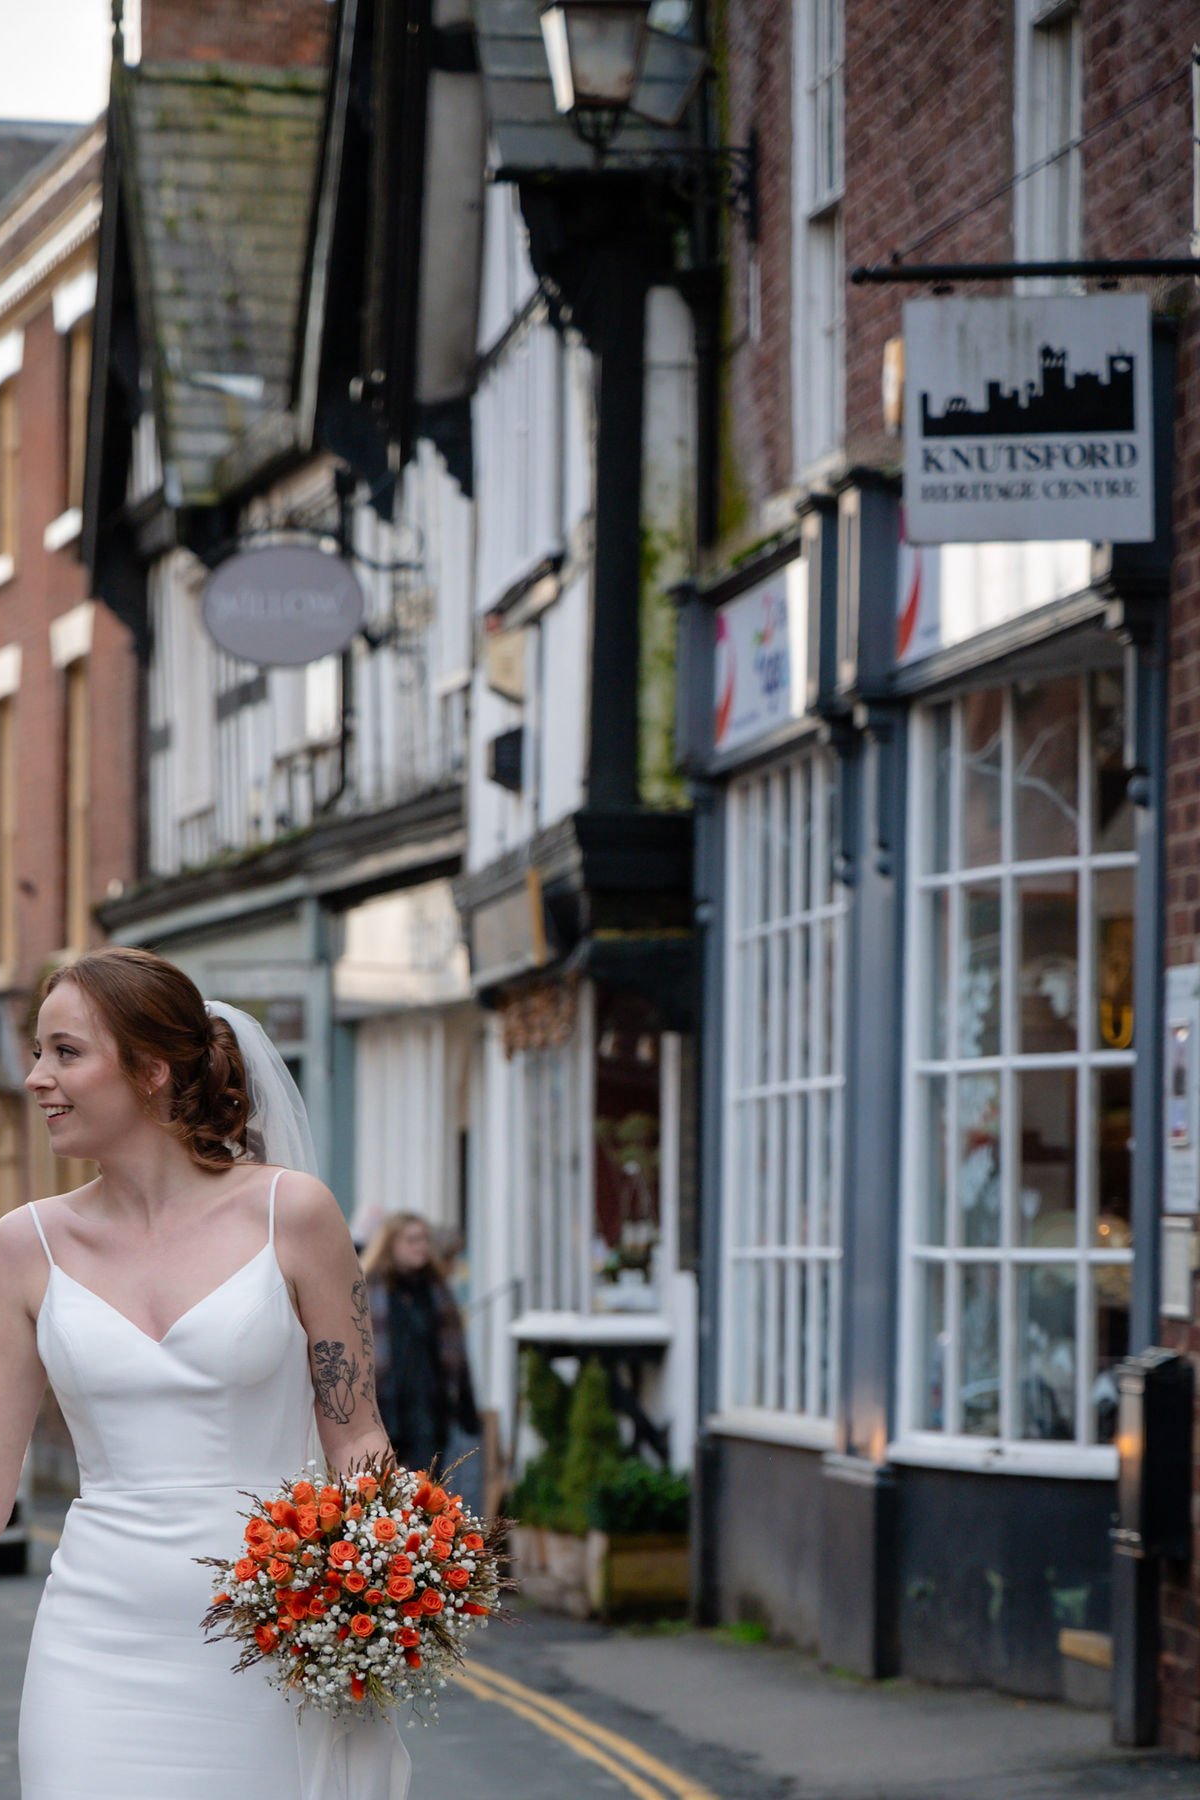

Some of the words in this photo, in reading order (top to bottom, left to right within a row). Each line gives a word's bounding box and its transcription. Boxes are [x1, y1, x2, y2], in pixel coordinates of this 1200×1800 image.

[921, 441, 1138, 474] KNUTSFORD
[920, 479, 1039, 503] HERITAGE
[1041, 477, 1140, 500] CENTRE
